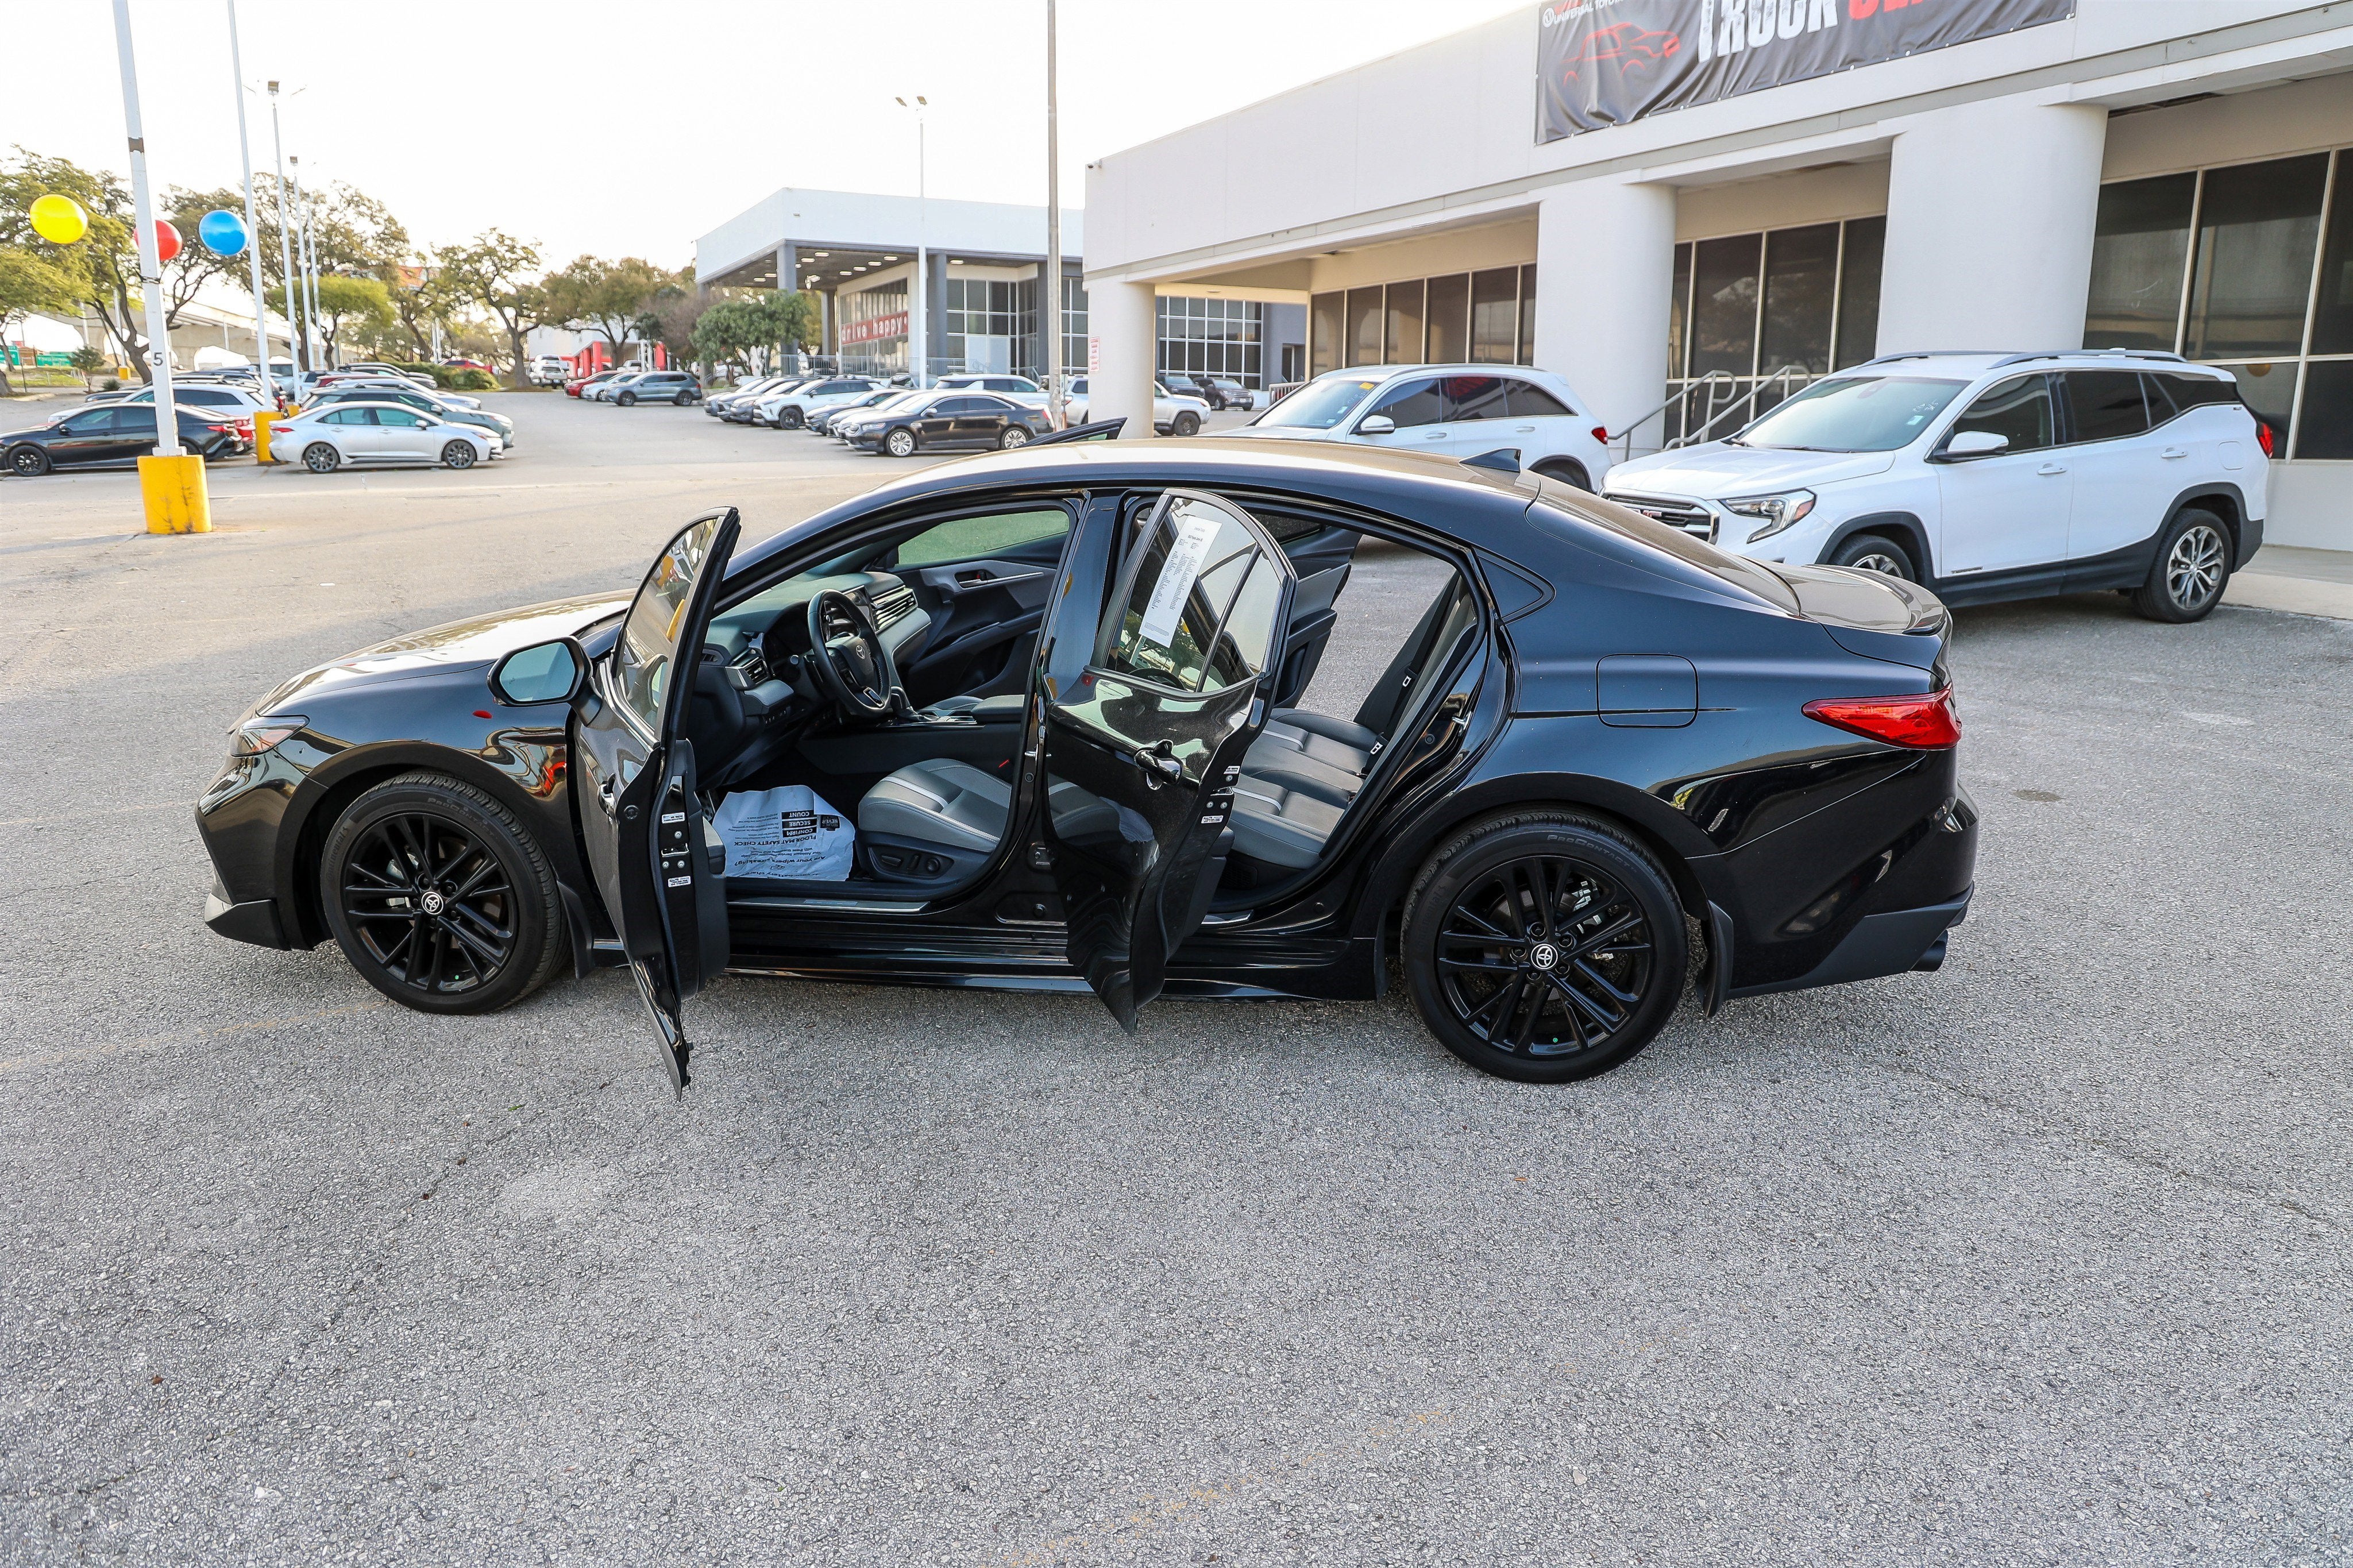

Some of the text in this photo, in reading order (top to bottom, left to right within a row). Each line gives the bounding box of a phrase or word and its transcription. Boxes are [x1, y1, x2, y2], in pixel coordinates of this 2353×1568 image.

[1554, 2, 1594, 25] UNIVERSAL
[842, 316, 902, 341] drive happy
[153, 352, 163, 366] 5
